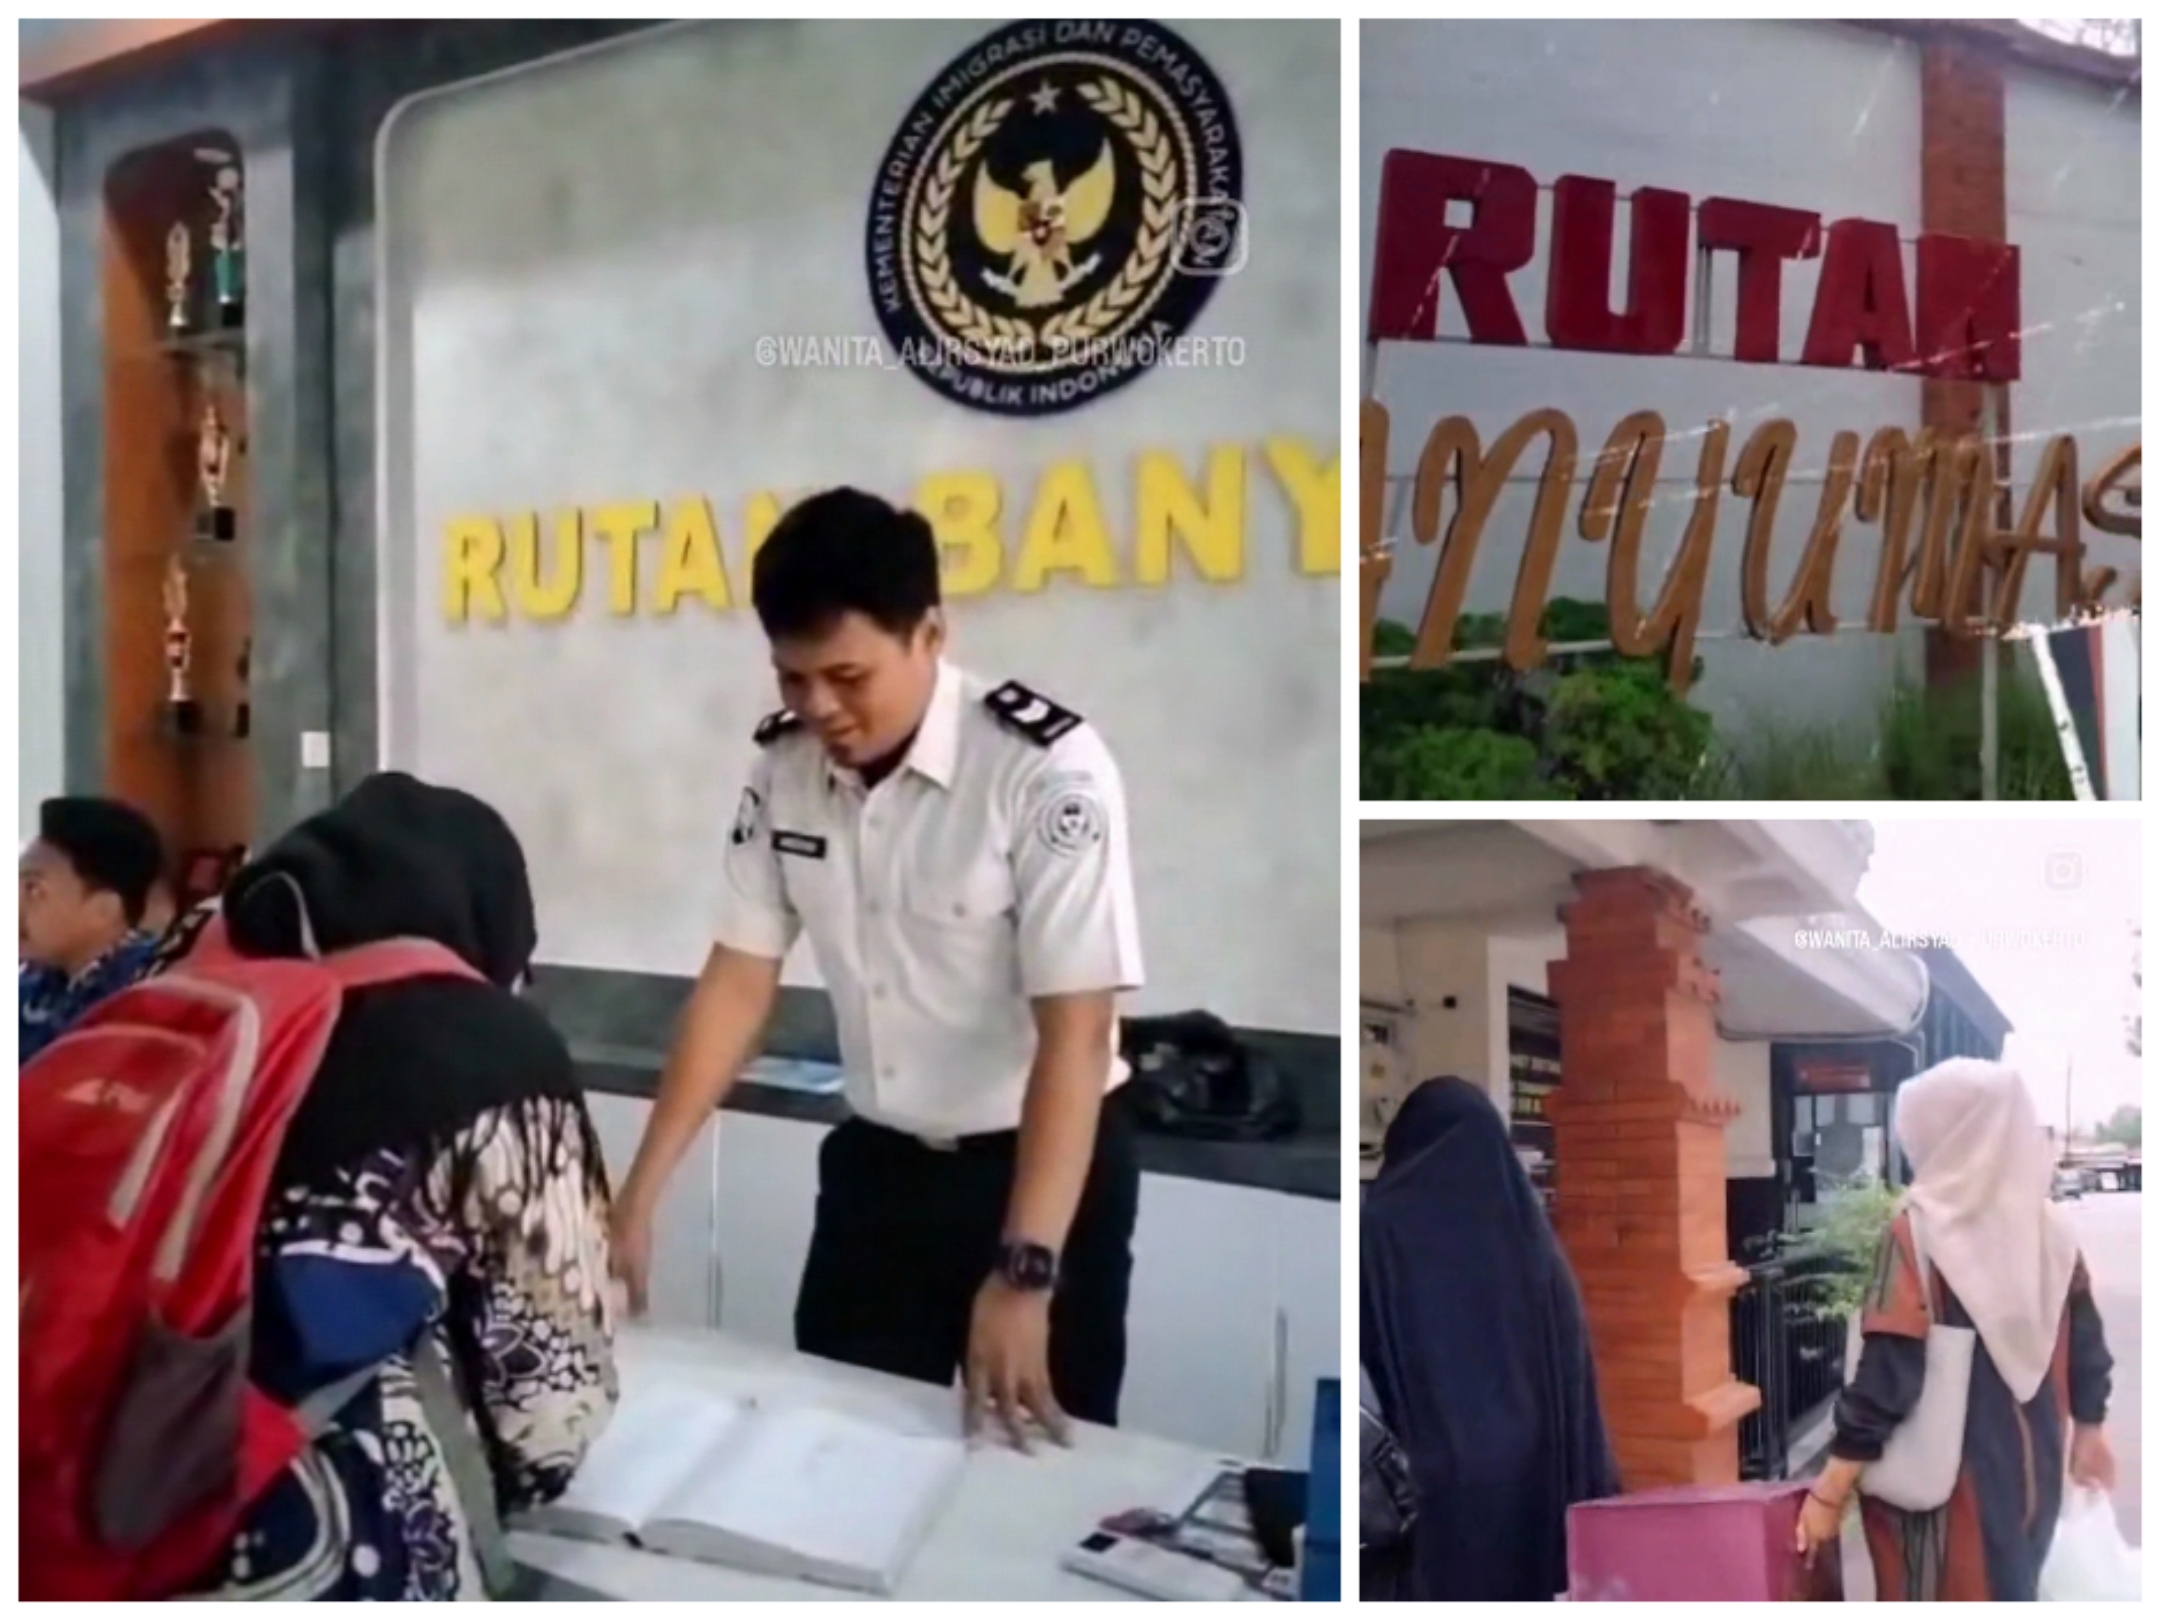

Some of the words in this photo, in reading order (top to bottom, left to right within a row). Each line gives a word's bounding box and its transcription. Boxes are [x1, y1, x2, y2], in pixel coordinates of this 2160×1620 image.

[873, 111, 935, 313] KEMENTERIAN
[932, 22, 1047, 108] IMIGRASI
[1054, 20, 1114, 45] DAN
[1370, 147, 2021, 381] RUTAN
[916, 434, 1340, 599] BANY
